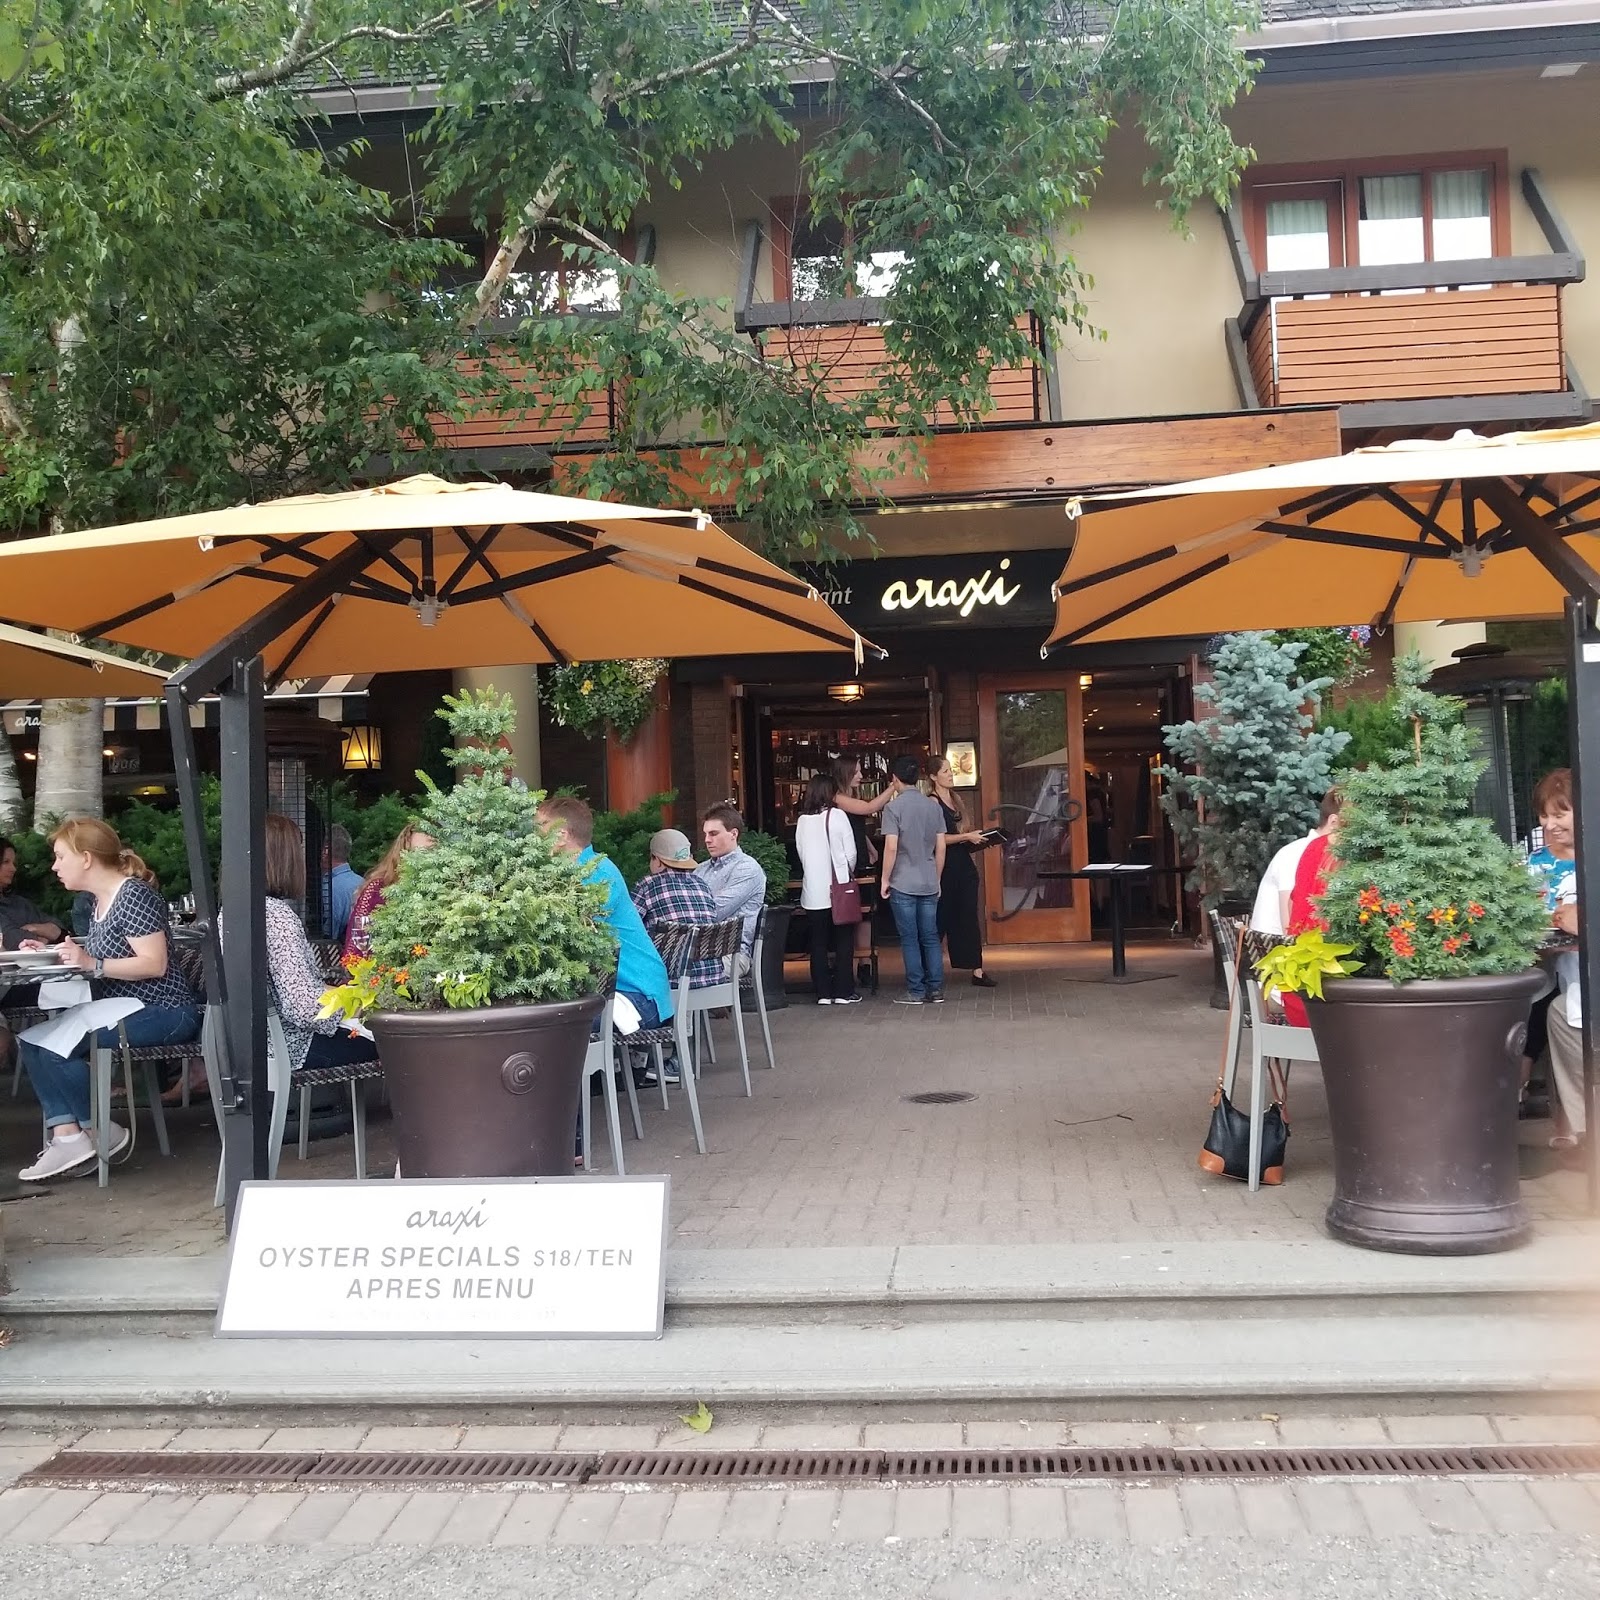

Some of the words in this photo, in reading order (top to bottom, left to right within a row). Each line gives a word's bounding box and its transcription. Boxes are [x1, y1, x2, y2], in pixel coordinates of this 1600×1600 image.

[880, 558, 1021, 618] araxi
[775, 753, 794, 763] bar
[405, 1198, 490, 1236] araxi
[259, 1247, 370, 1268] OYSTER
[380, 1246, 521, 1267] SPECIALS
[345, 1278, 441, 1299] APRES
[452, 1278, 534, 1299] MENU
